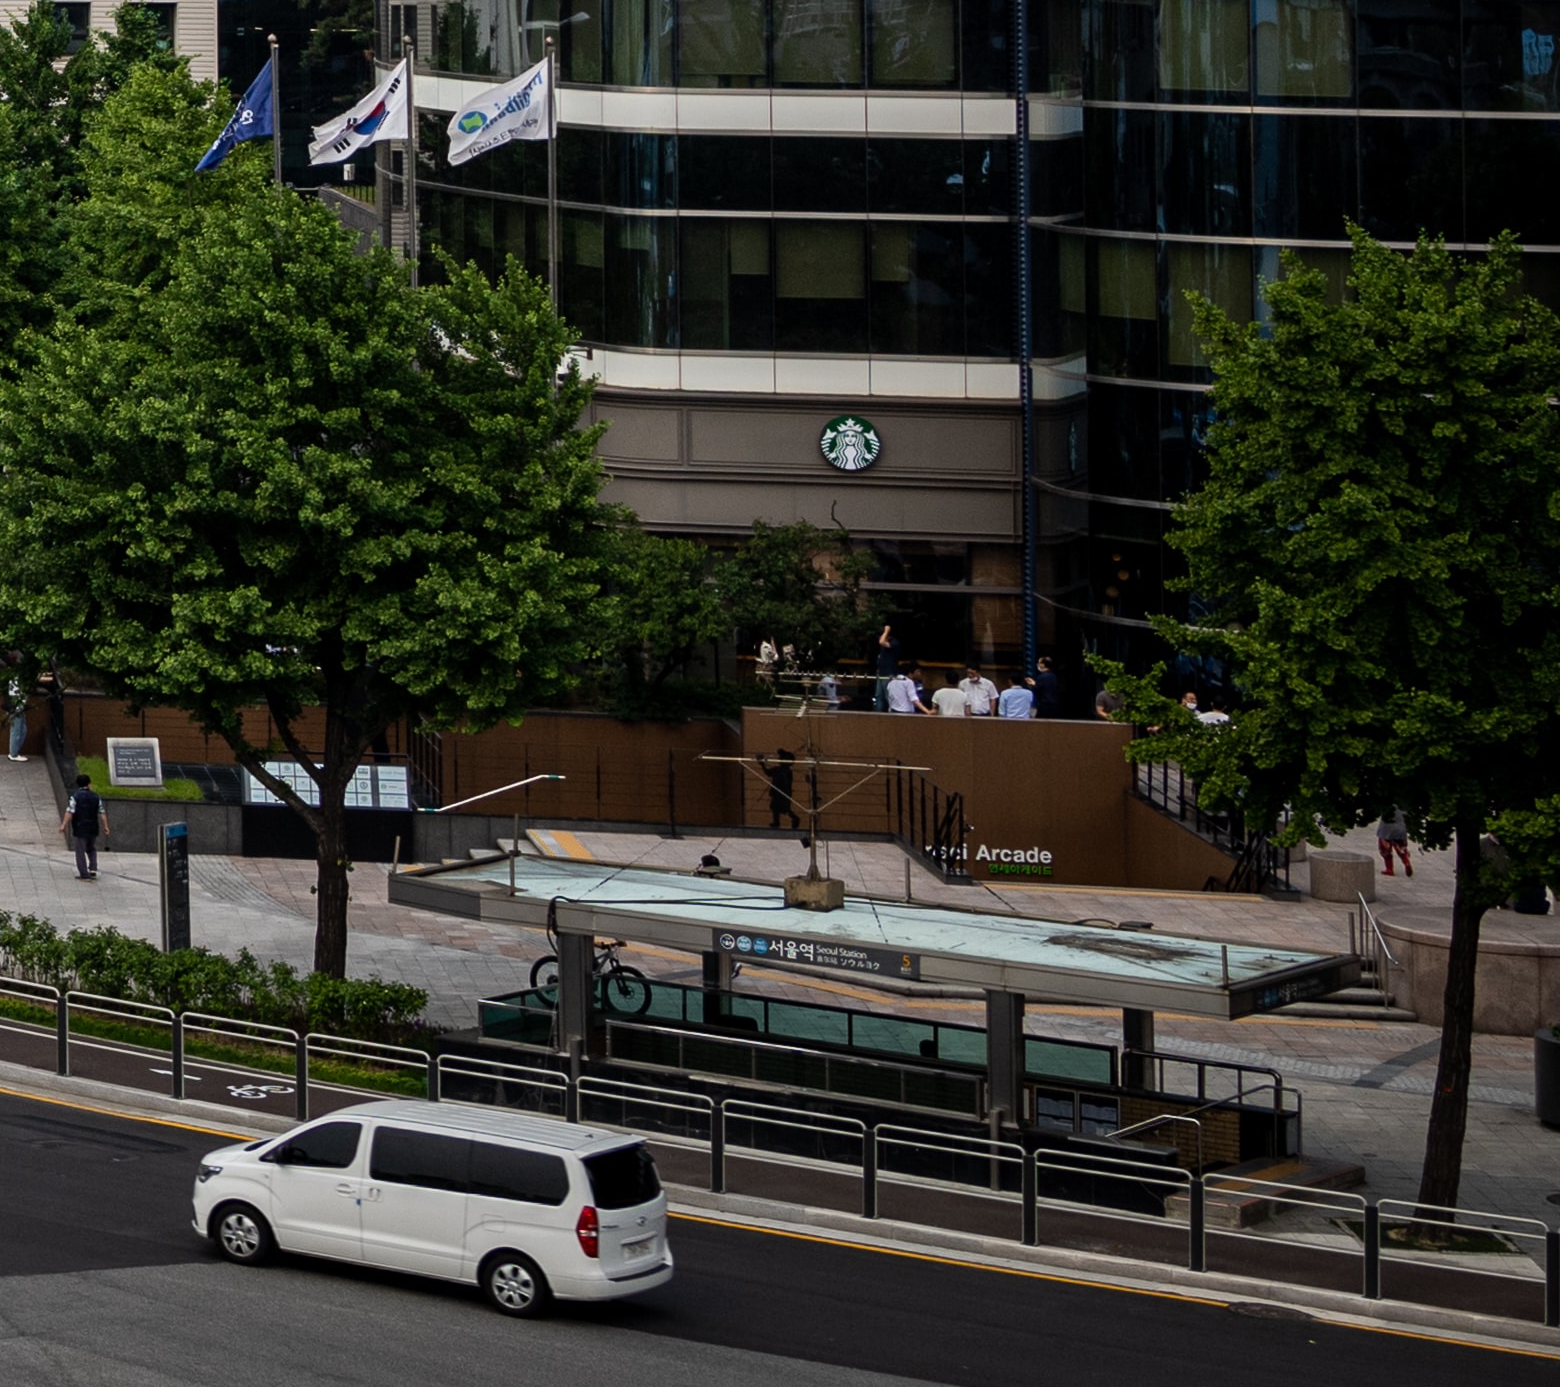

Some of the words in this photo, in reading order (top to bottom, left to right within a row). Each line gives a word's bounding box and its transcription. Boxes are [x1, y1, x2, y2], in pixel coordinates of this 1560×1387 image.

[975, 843, 1052, 864] Arcade
[769, 939, 814, 962] 서울역
[815, 944, 839, 957] Seoul
[839, 948, 868, 961] Station
[902, 955, 911, 968] 5
